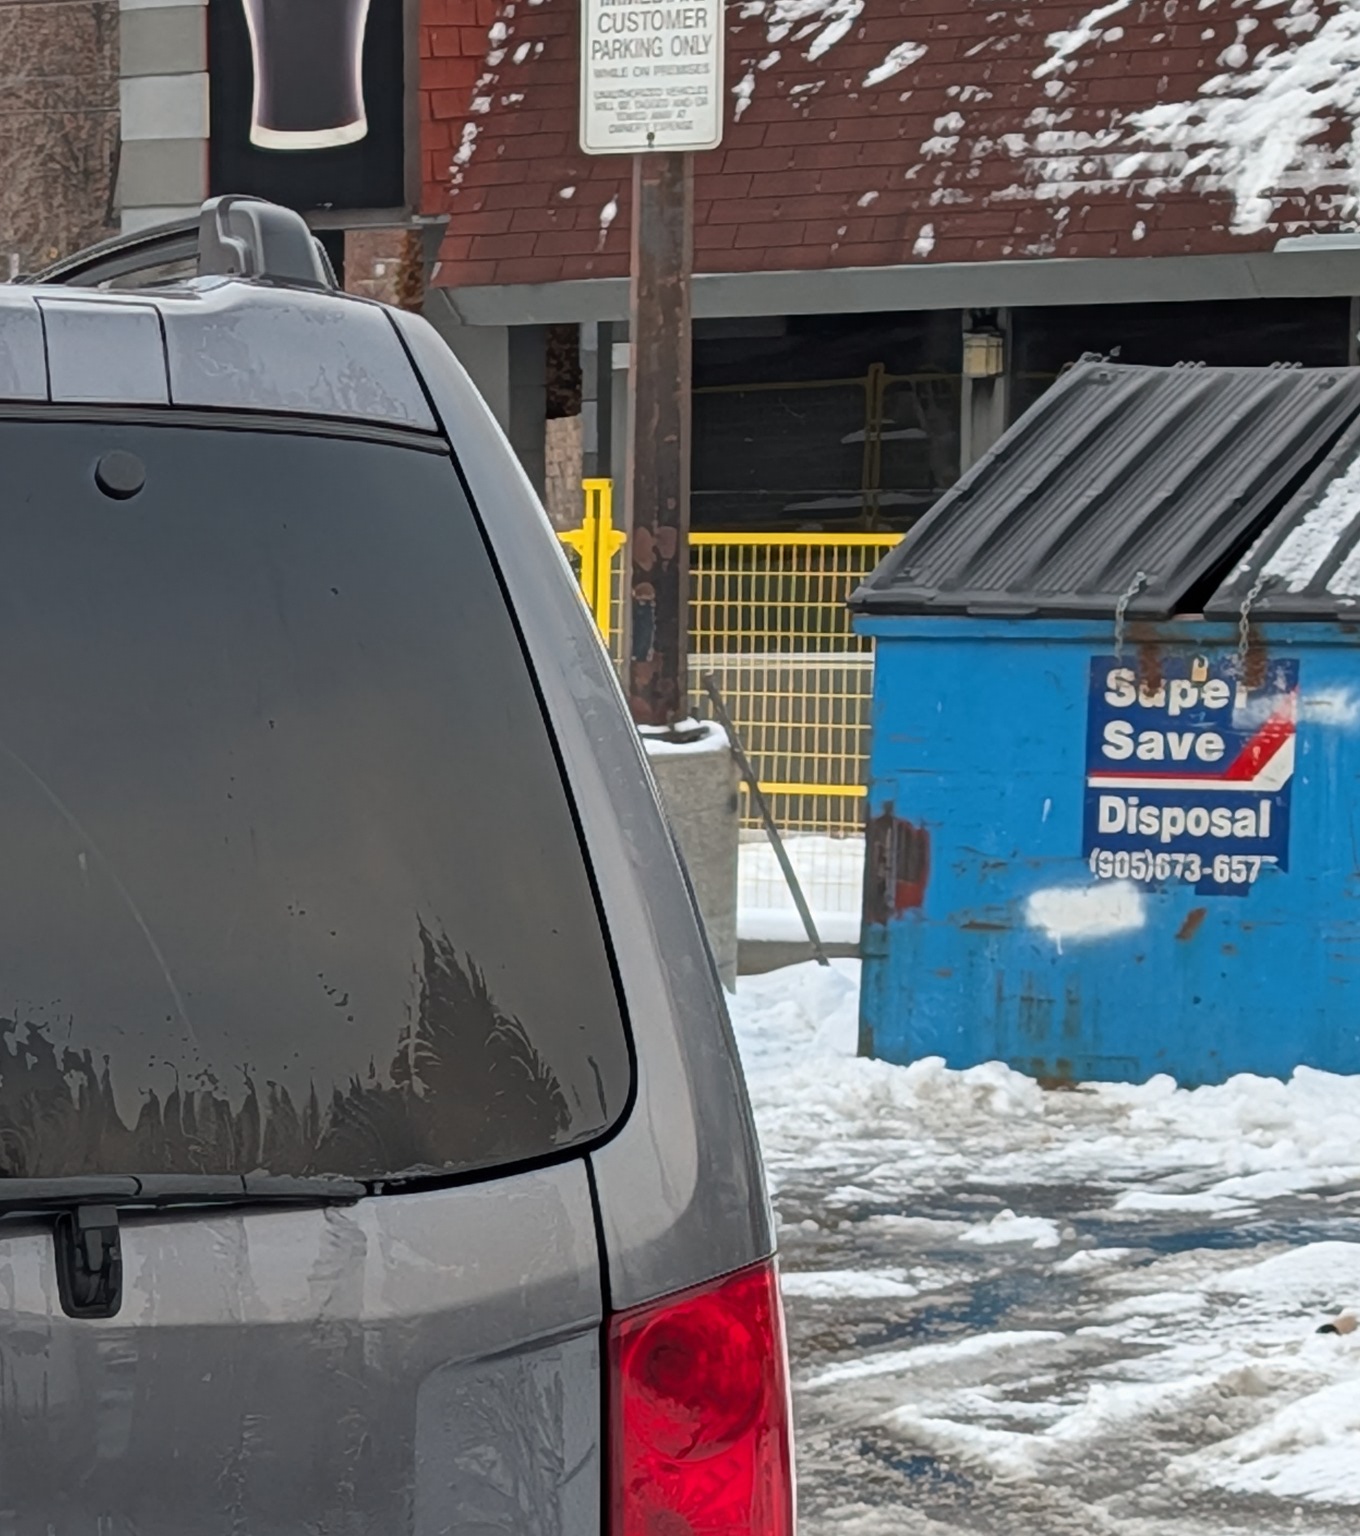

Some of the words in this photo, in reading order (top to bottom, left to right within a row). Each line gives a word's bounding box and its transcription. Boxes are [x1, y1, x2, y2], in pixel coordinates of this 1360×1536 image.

[598, 8, 707, 33] CUSTOMER
[591, 36, 663, 60] PARKING
[670, 34, 712, 57] ONLY
[1101, 719, 1226, 762] Save
[1098, 795, 1272, 843] Disposal
